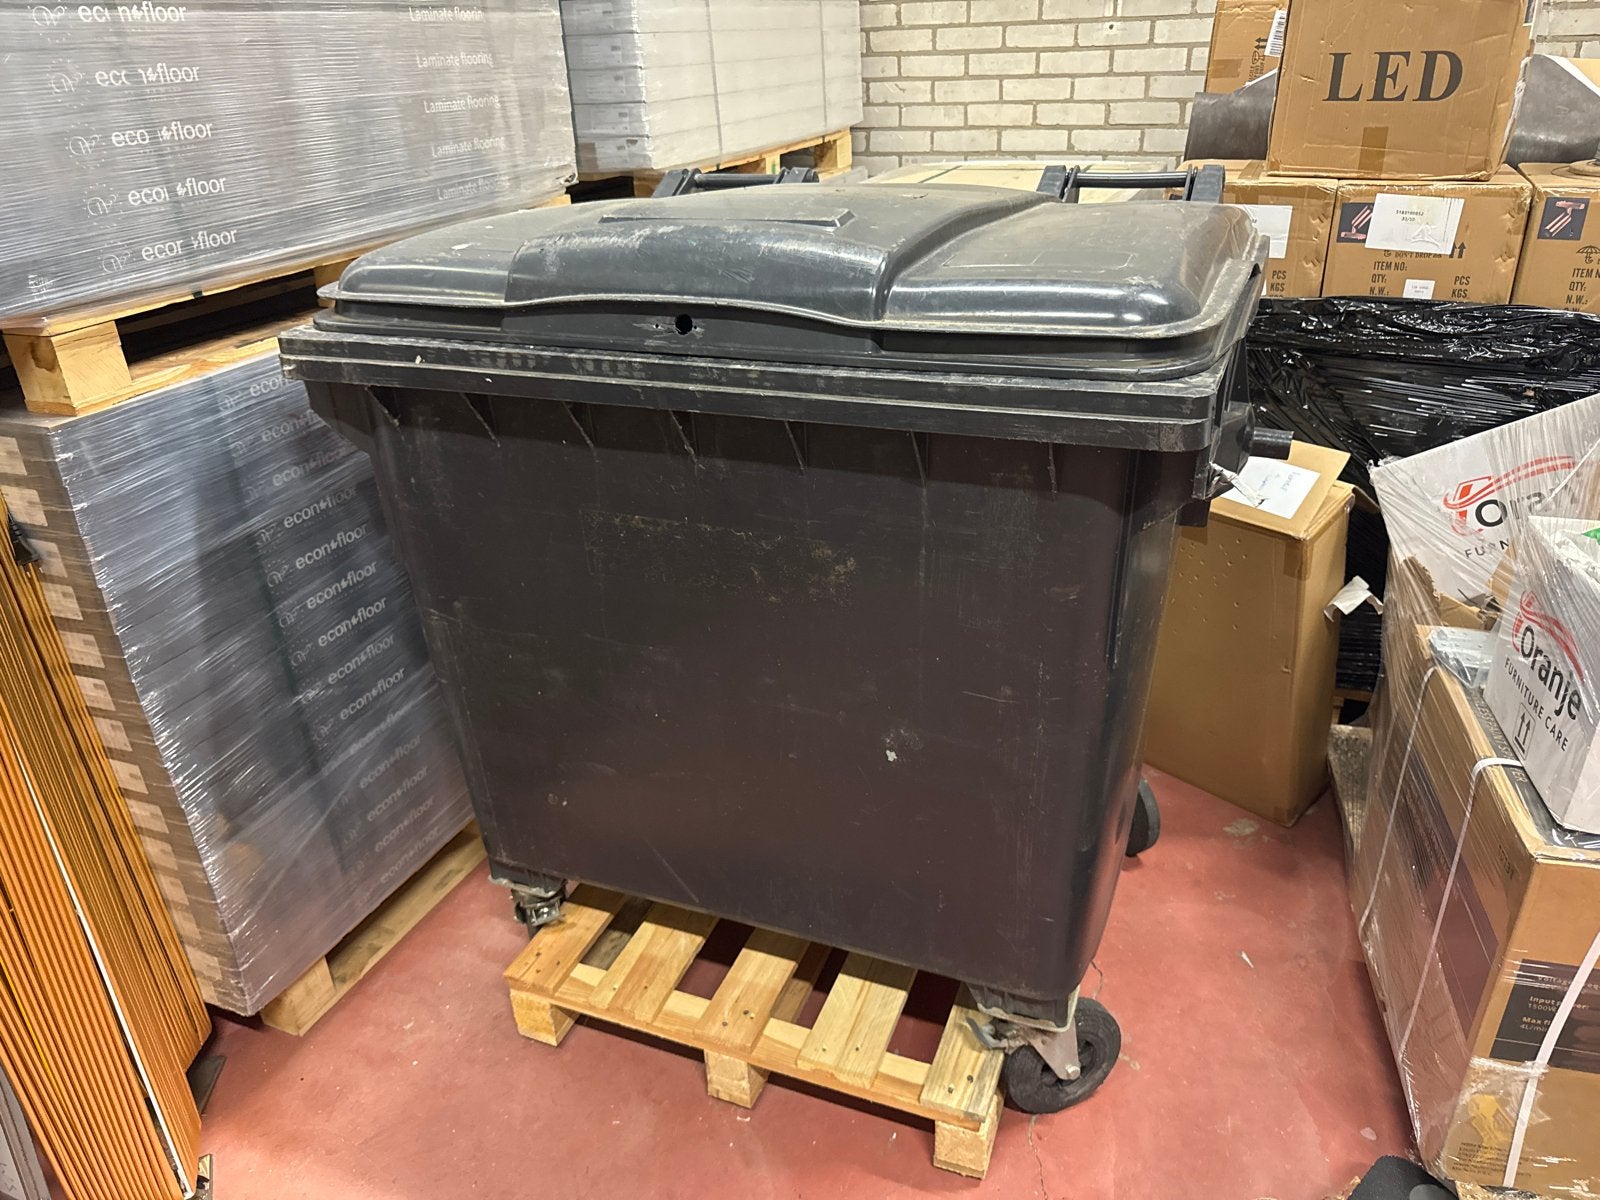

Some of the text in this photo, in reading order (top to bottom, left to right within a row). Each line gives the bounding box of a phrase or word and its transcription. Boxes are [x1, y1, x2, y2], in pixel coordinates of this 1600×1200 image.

[1322, 50, 1463, 101] LED
[1373, 261, 1408, 272] ITEM NO:
[1271, 270, 1287, 280] PCS
[1571, 267, 1594, 279] ITEM
[1371, 273, 1471, 286] QTY: PCS
[1270, 282, 1285, 292] KGS
[1569, 281, 1587, 292] QTY:
[1451, 288, 1468, 299] KGS
[1520, 624, 1582, 721] Oranje
[1504, 656, 1569, 752] FURNITURE CARE
[1538, 975, 1571, 986] Voltag
[1529, 996, 1556, 1006] Input
[1522, 1016, 1541, 1025] Max
